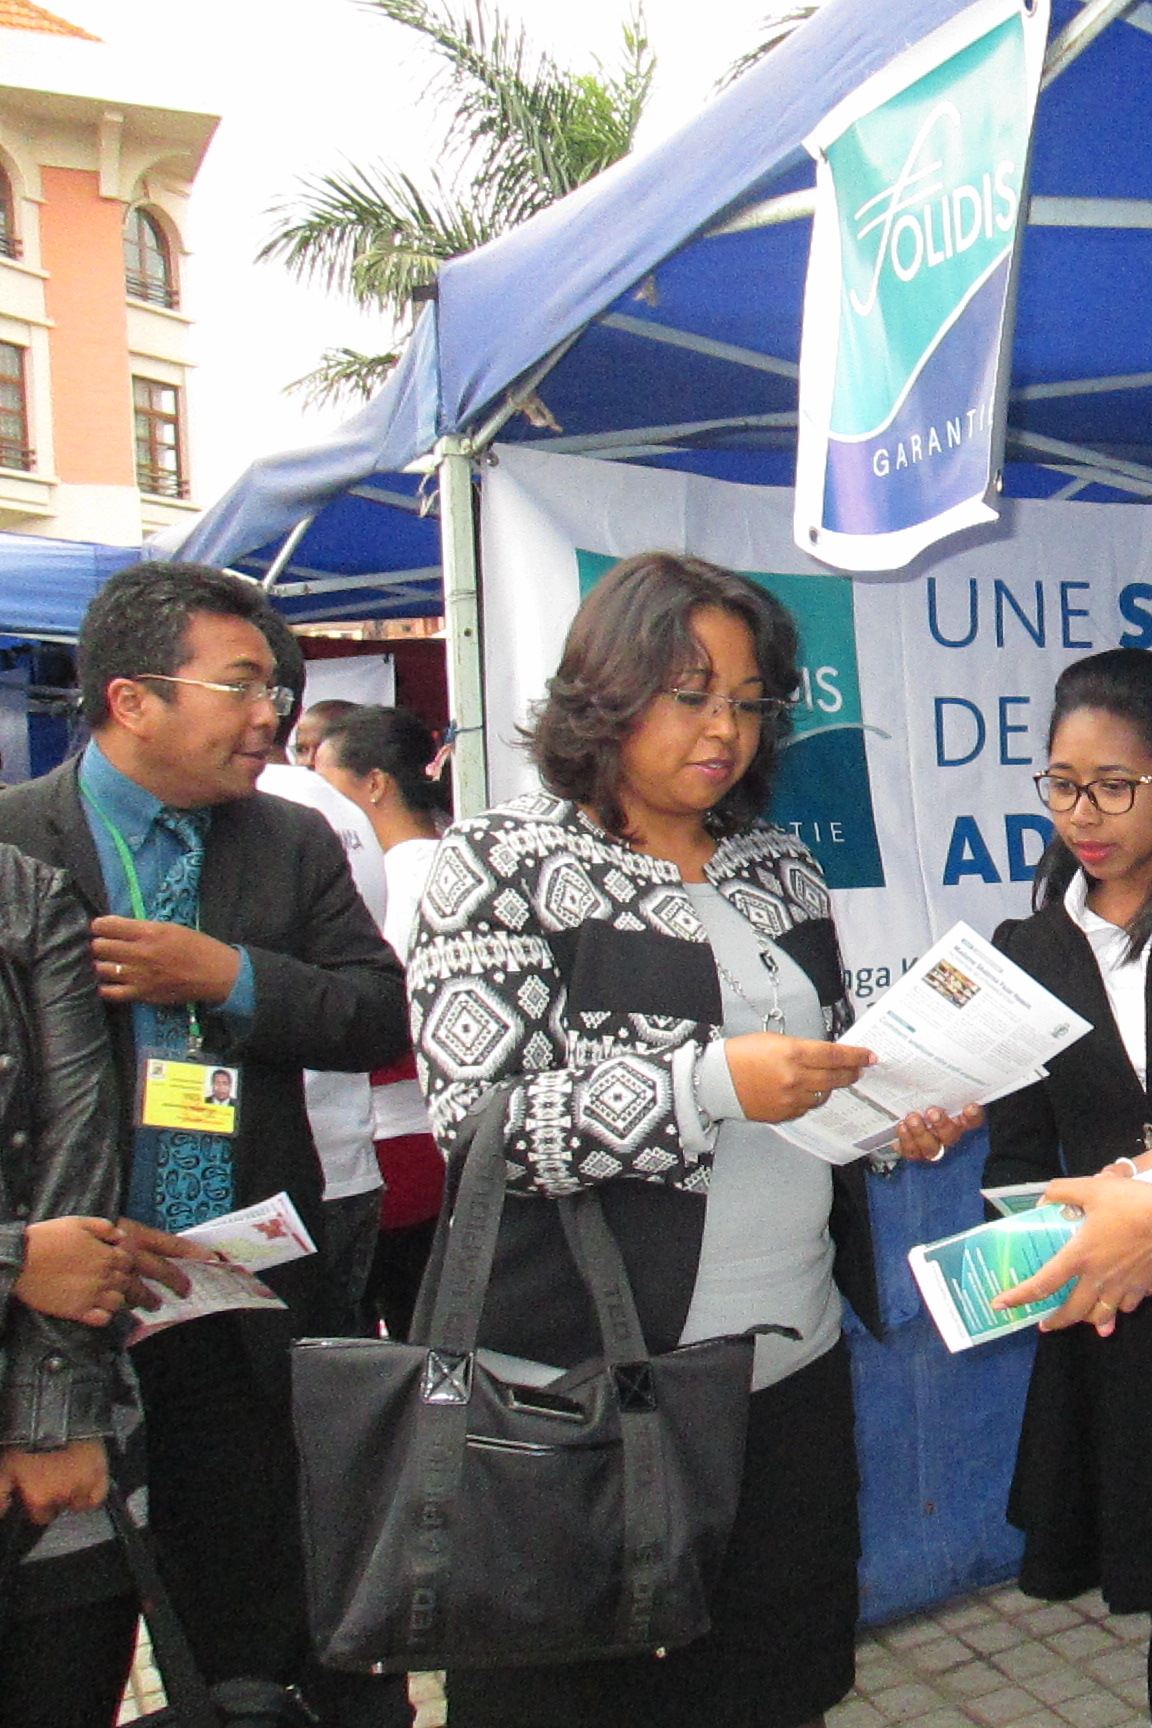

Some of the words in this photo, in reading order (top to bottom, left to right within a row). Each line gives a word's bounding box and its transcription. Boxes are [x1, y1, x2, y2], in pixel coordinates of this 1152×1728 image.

[872, 403, 993, 478] GARANTI
[926, 577, 1093, 649] UNE
[934, 696, 1033, 768] DE
